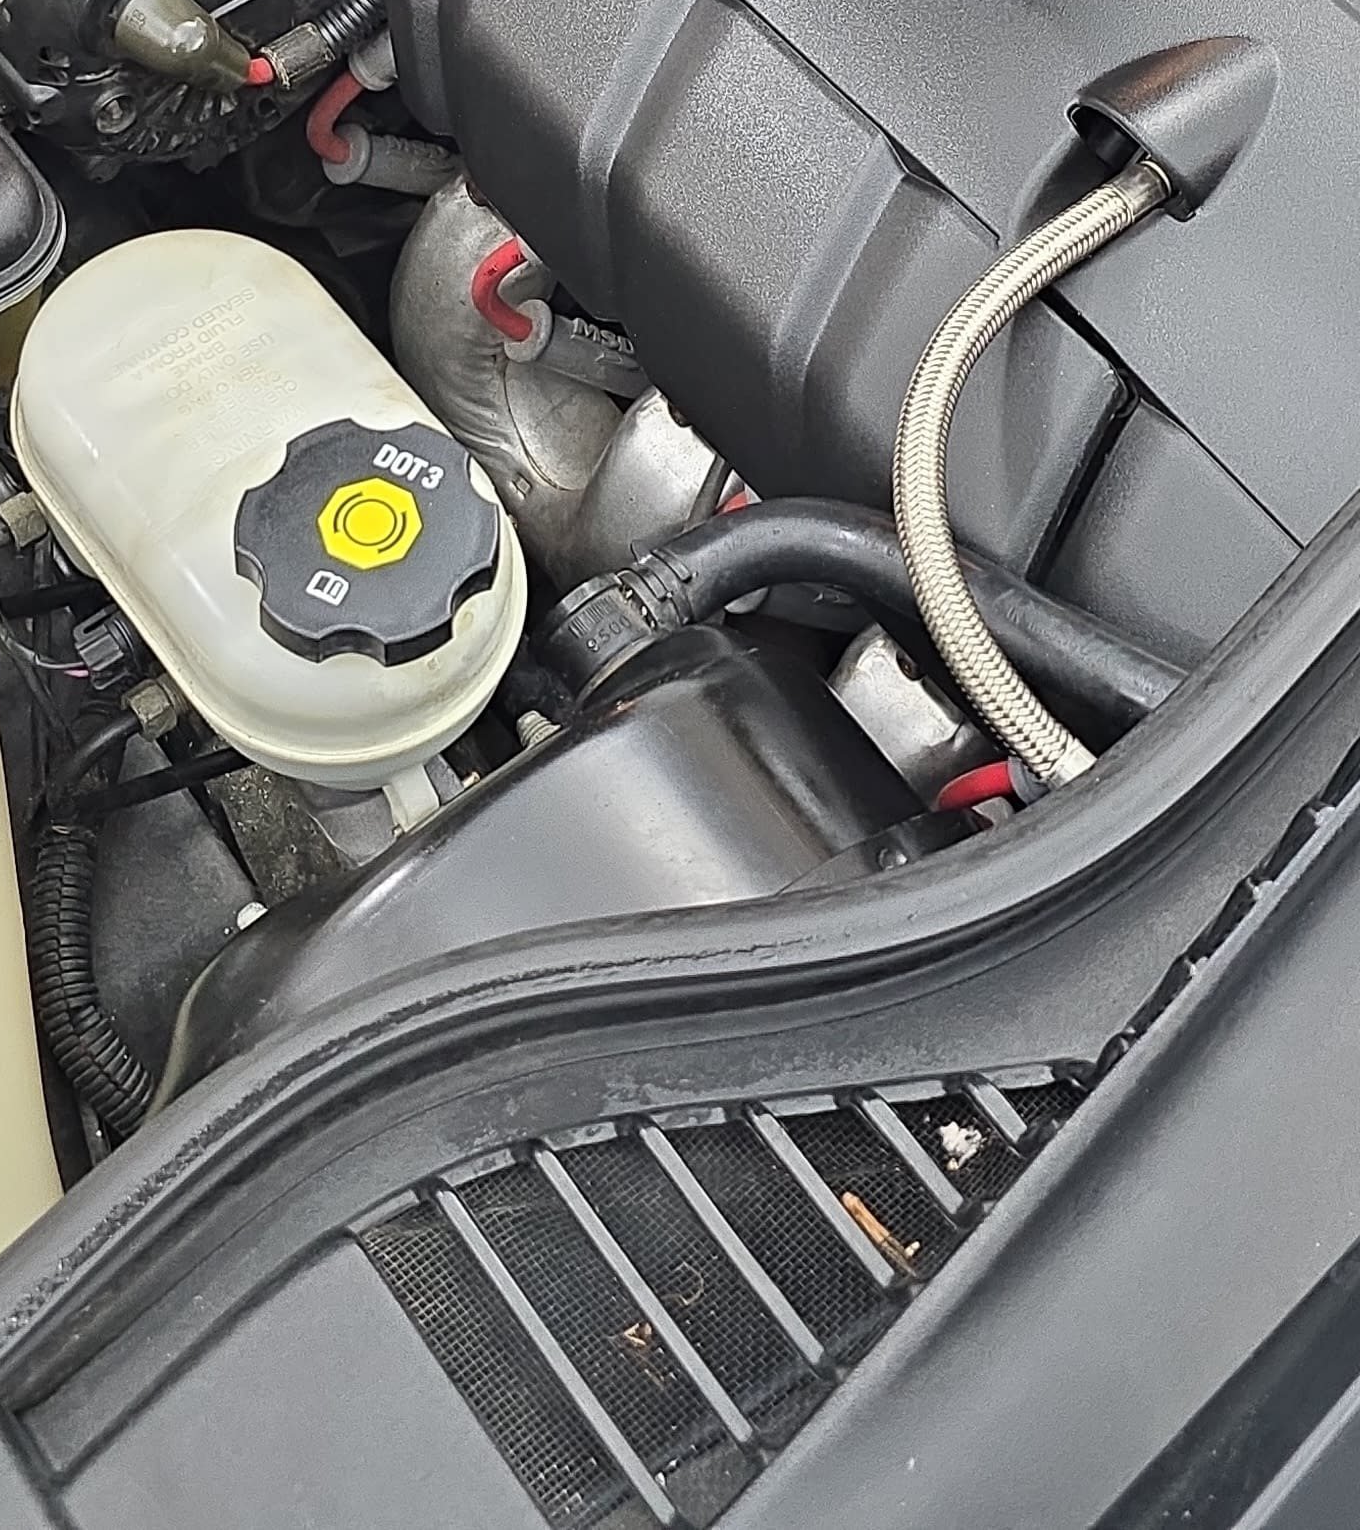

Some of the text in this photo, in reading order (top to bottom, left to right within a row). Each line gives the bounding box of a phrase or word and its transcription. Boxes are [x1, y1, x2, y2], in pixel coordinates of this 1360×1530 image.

[192, 287, 256, 329] SEALED
[197, 314, 245, 344] FLUID
[240, 331, 275, 358] USE
[570, 317, 635, 355] MSD
[170, 340, 226, 379] BRAKE
